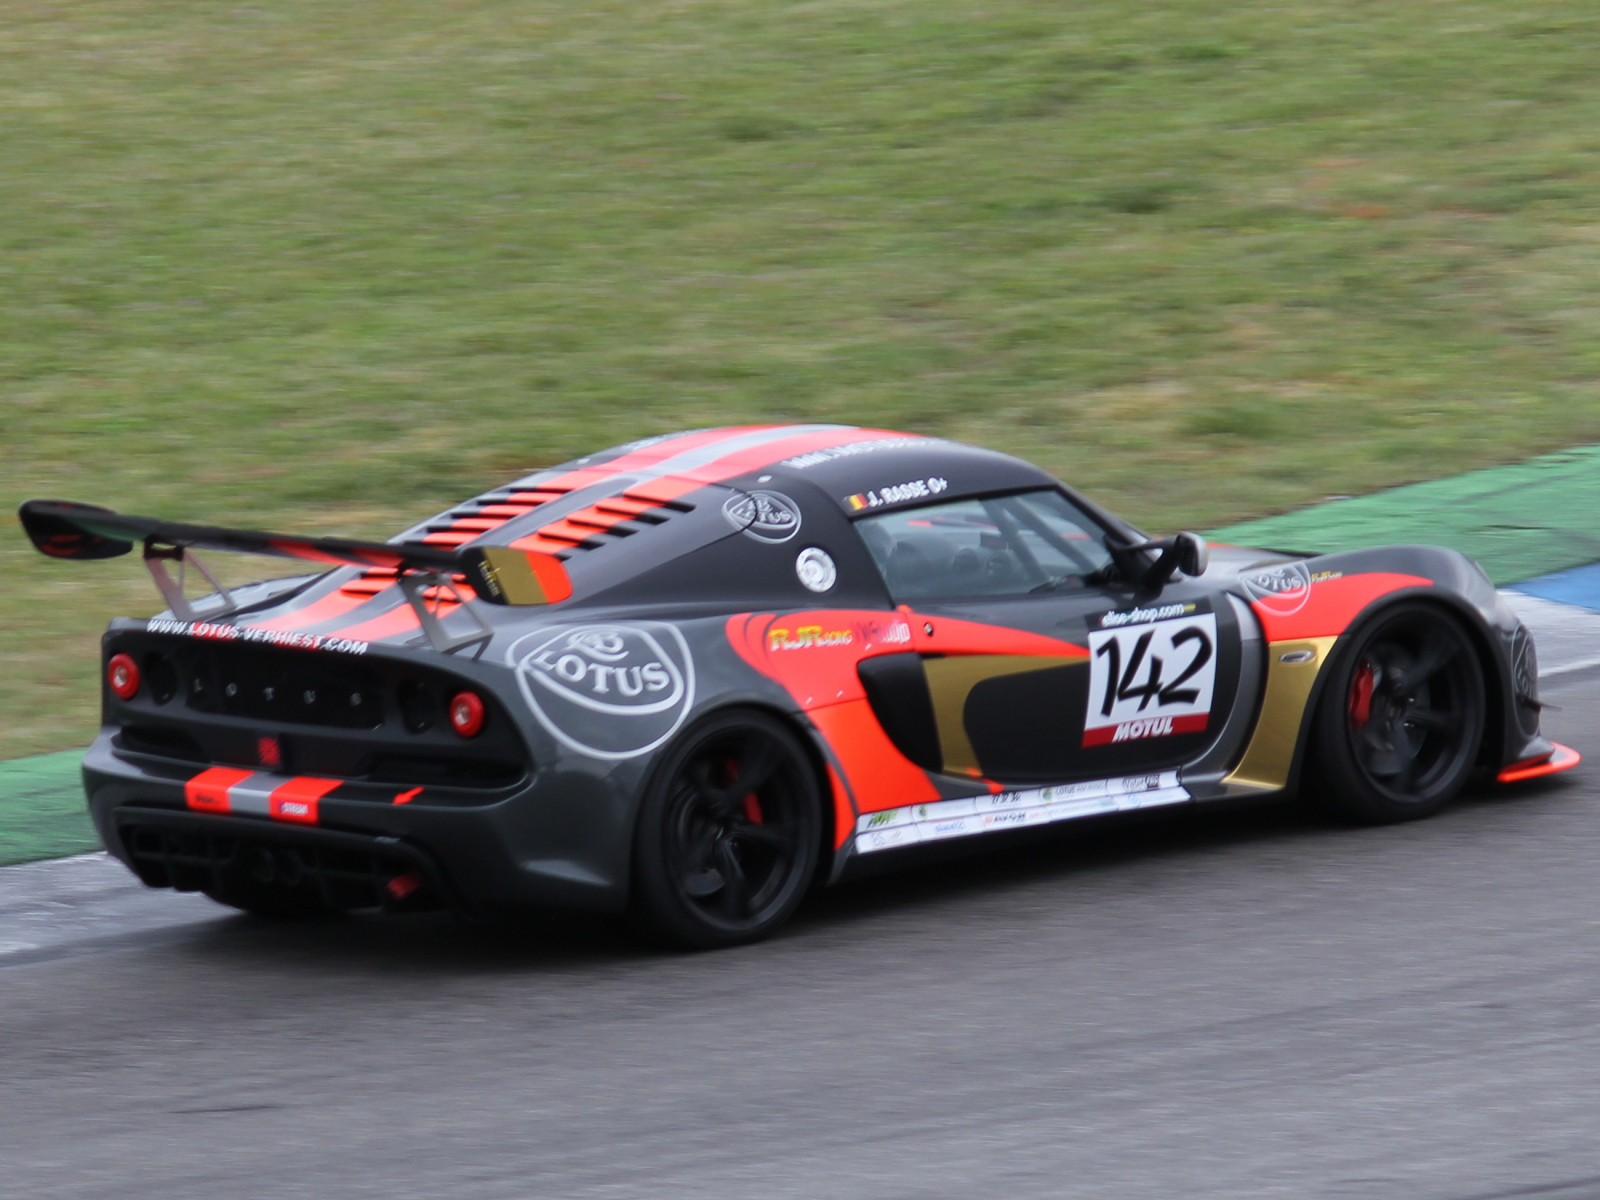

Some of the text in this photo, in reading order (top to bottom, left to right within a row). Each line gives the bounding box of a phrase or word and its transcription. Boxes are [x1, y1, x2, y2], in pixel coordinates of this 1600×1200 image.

[879, 480, 930, 504] RASSE
[1101, 603, 1185, 627] elise-shop.com
[530, 650, 670, 697] LOTUS
[1096, 625, 1213, 719] 142
[1111, 716, 1174, 744] MOTUL
